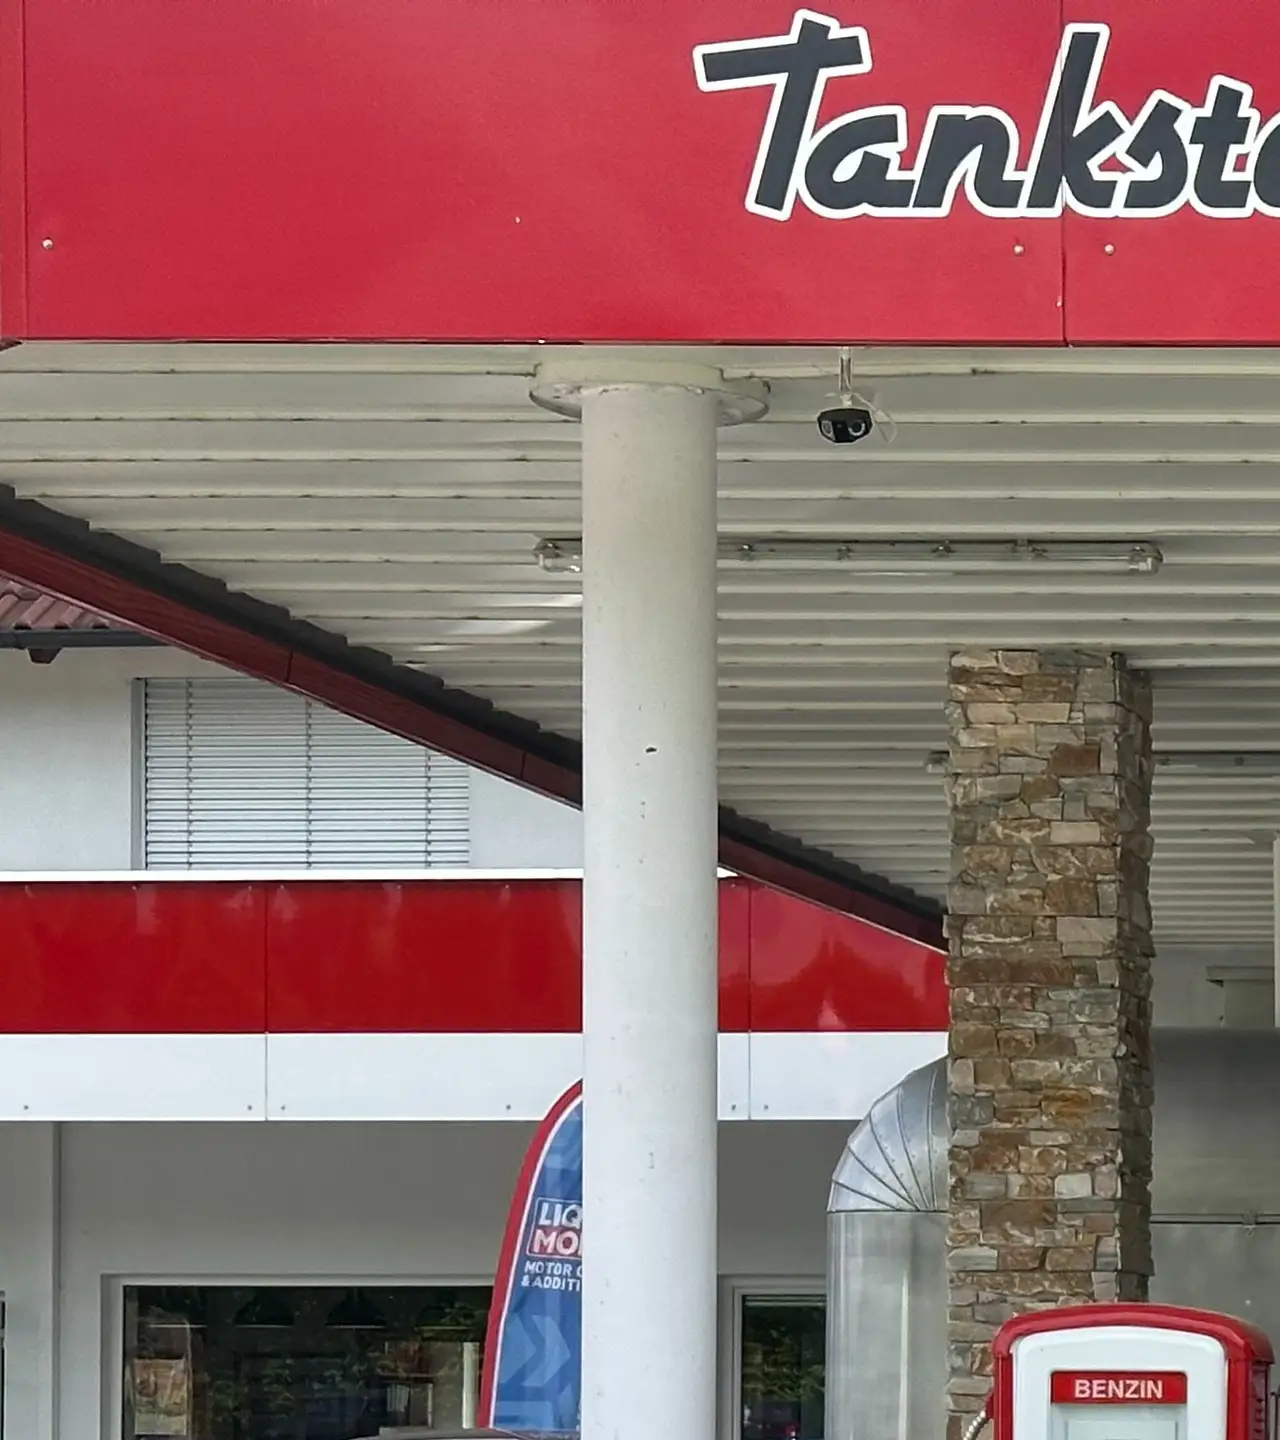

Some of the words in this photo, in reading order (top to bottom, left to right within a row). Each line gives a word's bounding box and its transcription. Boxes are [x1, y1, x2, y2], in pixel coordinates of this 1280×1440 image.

[539, 1203, 582, 1229] LIQ
[533, 1229, 582, 1256] MO
[524, 1261, 573, 1277] MOTOR
[1074, 1379, 1163, 1399] BENZIN
